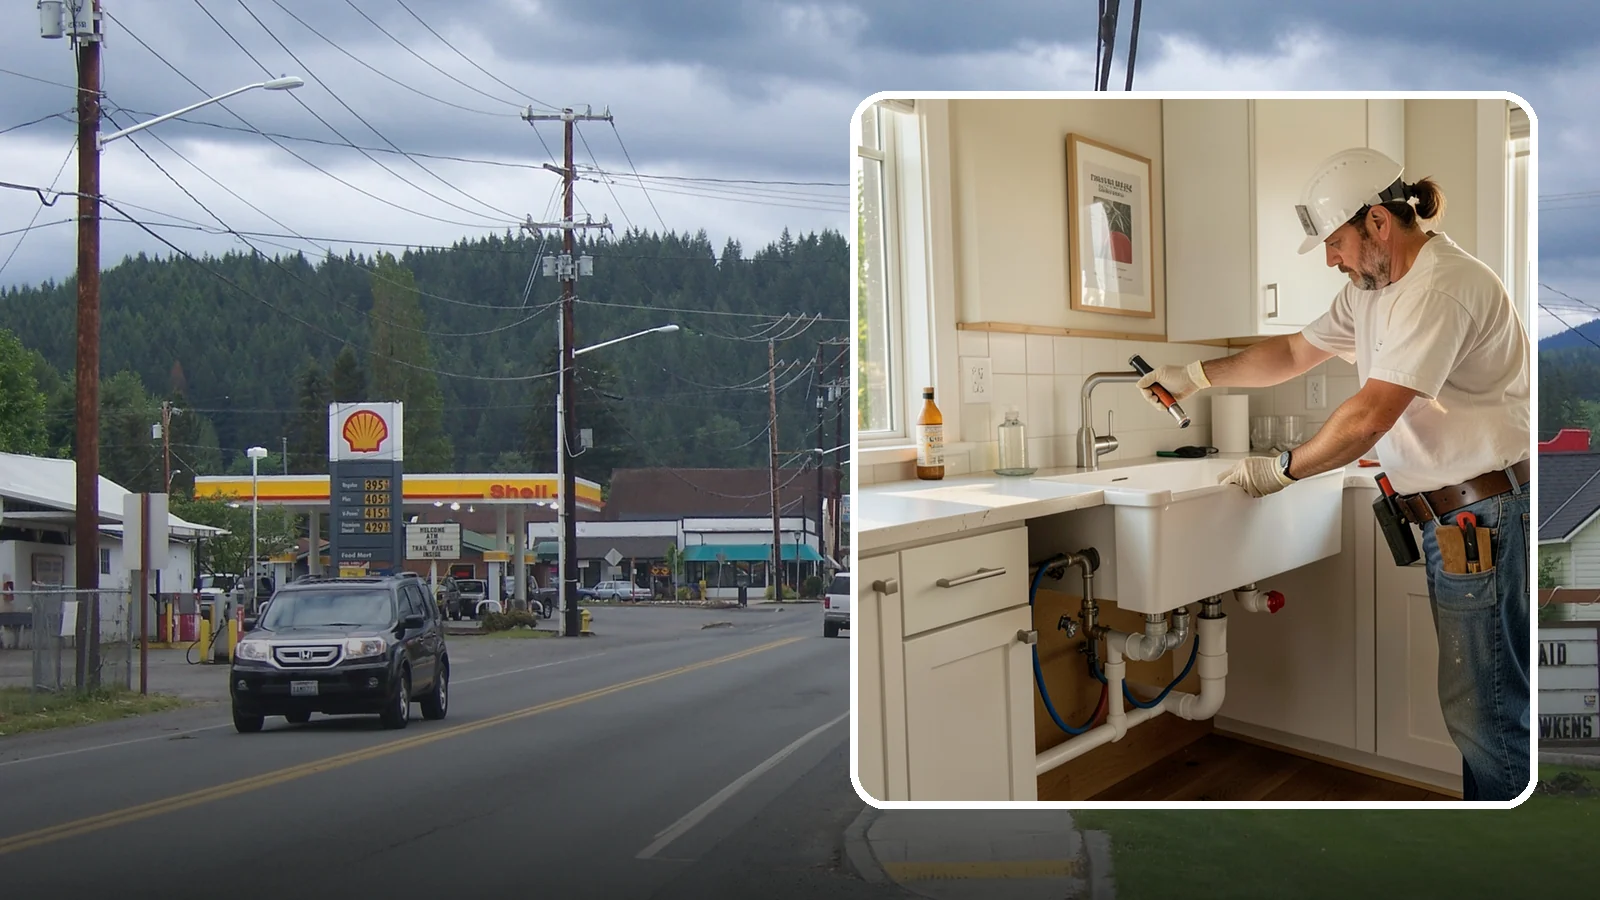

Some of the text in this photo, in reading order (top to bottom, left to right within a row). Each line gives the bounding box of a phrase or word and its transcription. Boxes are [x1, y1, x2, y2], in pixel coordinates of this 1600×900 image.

[365, 480, 384, 490] 395
[490, 484, 547, 499] Shell
[365, 494, 384, 504] 405
[365, 508, 384, 518] 415
[366, 522, 384, 533] 429
[1539, 643, 1566, 665] AID
